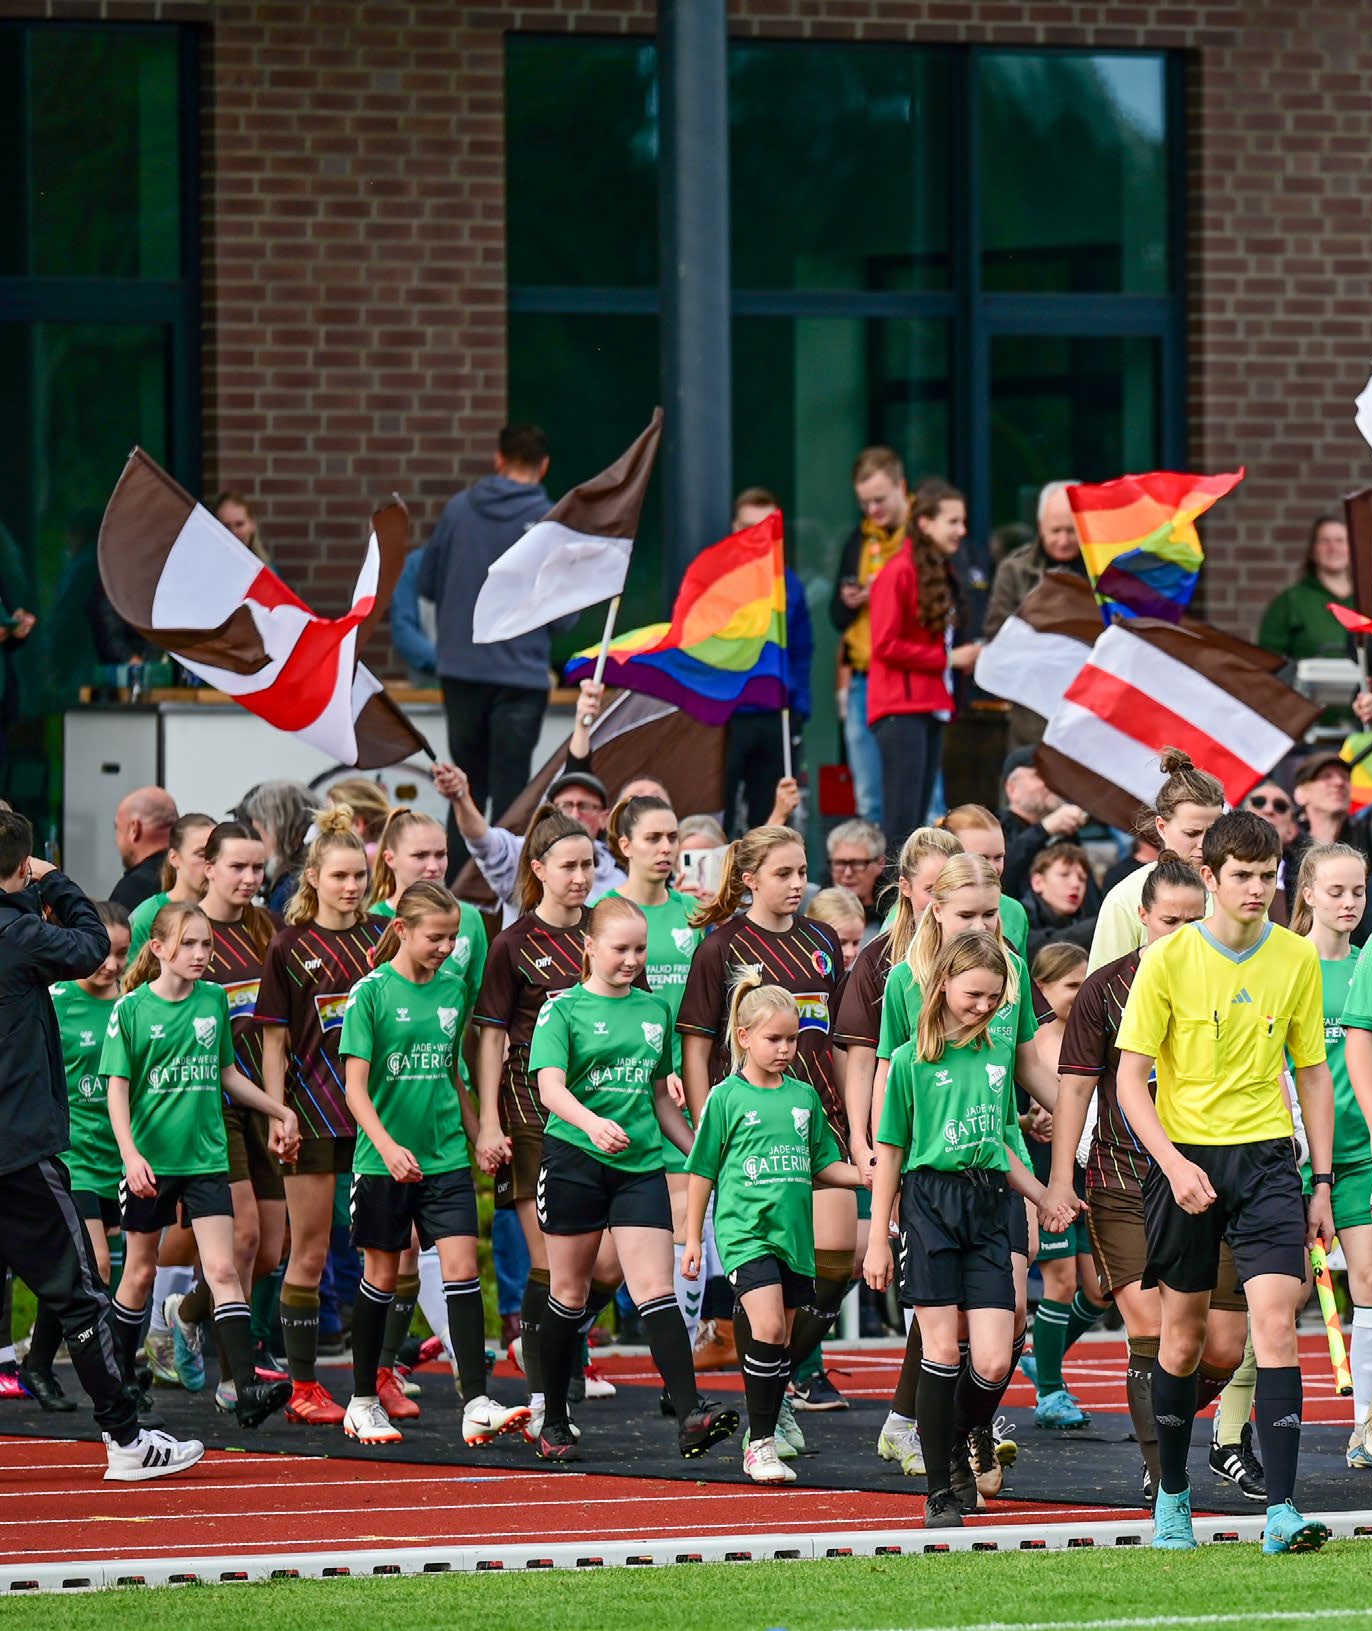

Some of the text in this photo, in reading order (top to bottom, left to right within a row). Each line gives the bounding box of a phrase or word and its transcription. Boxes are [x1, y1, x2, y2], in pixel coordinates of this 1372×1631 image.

[412, 1043, 432, 1053] JADE
[616, 1057, 638, 1067] JADE
[966, 1104, 987, 1118] JADE
[769, 1145, 791, 1155] JADE
